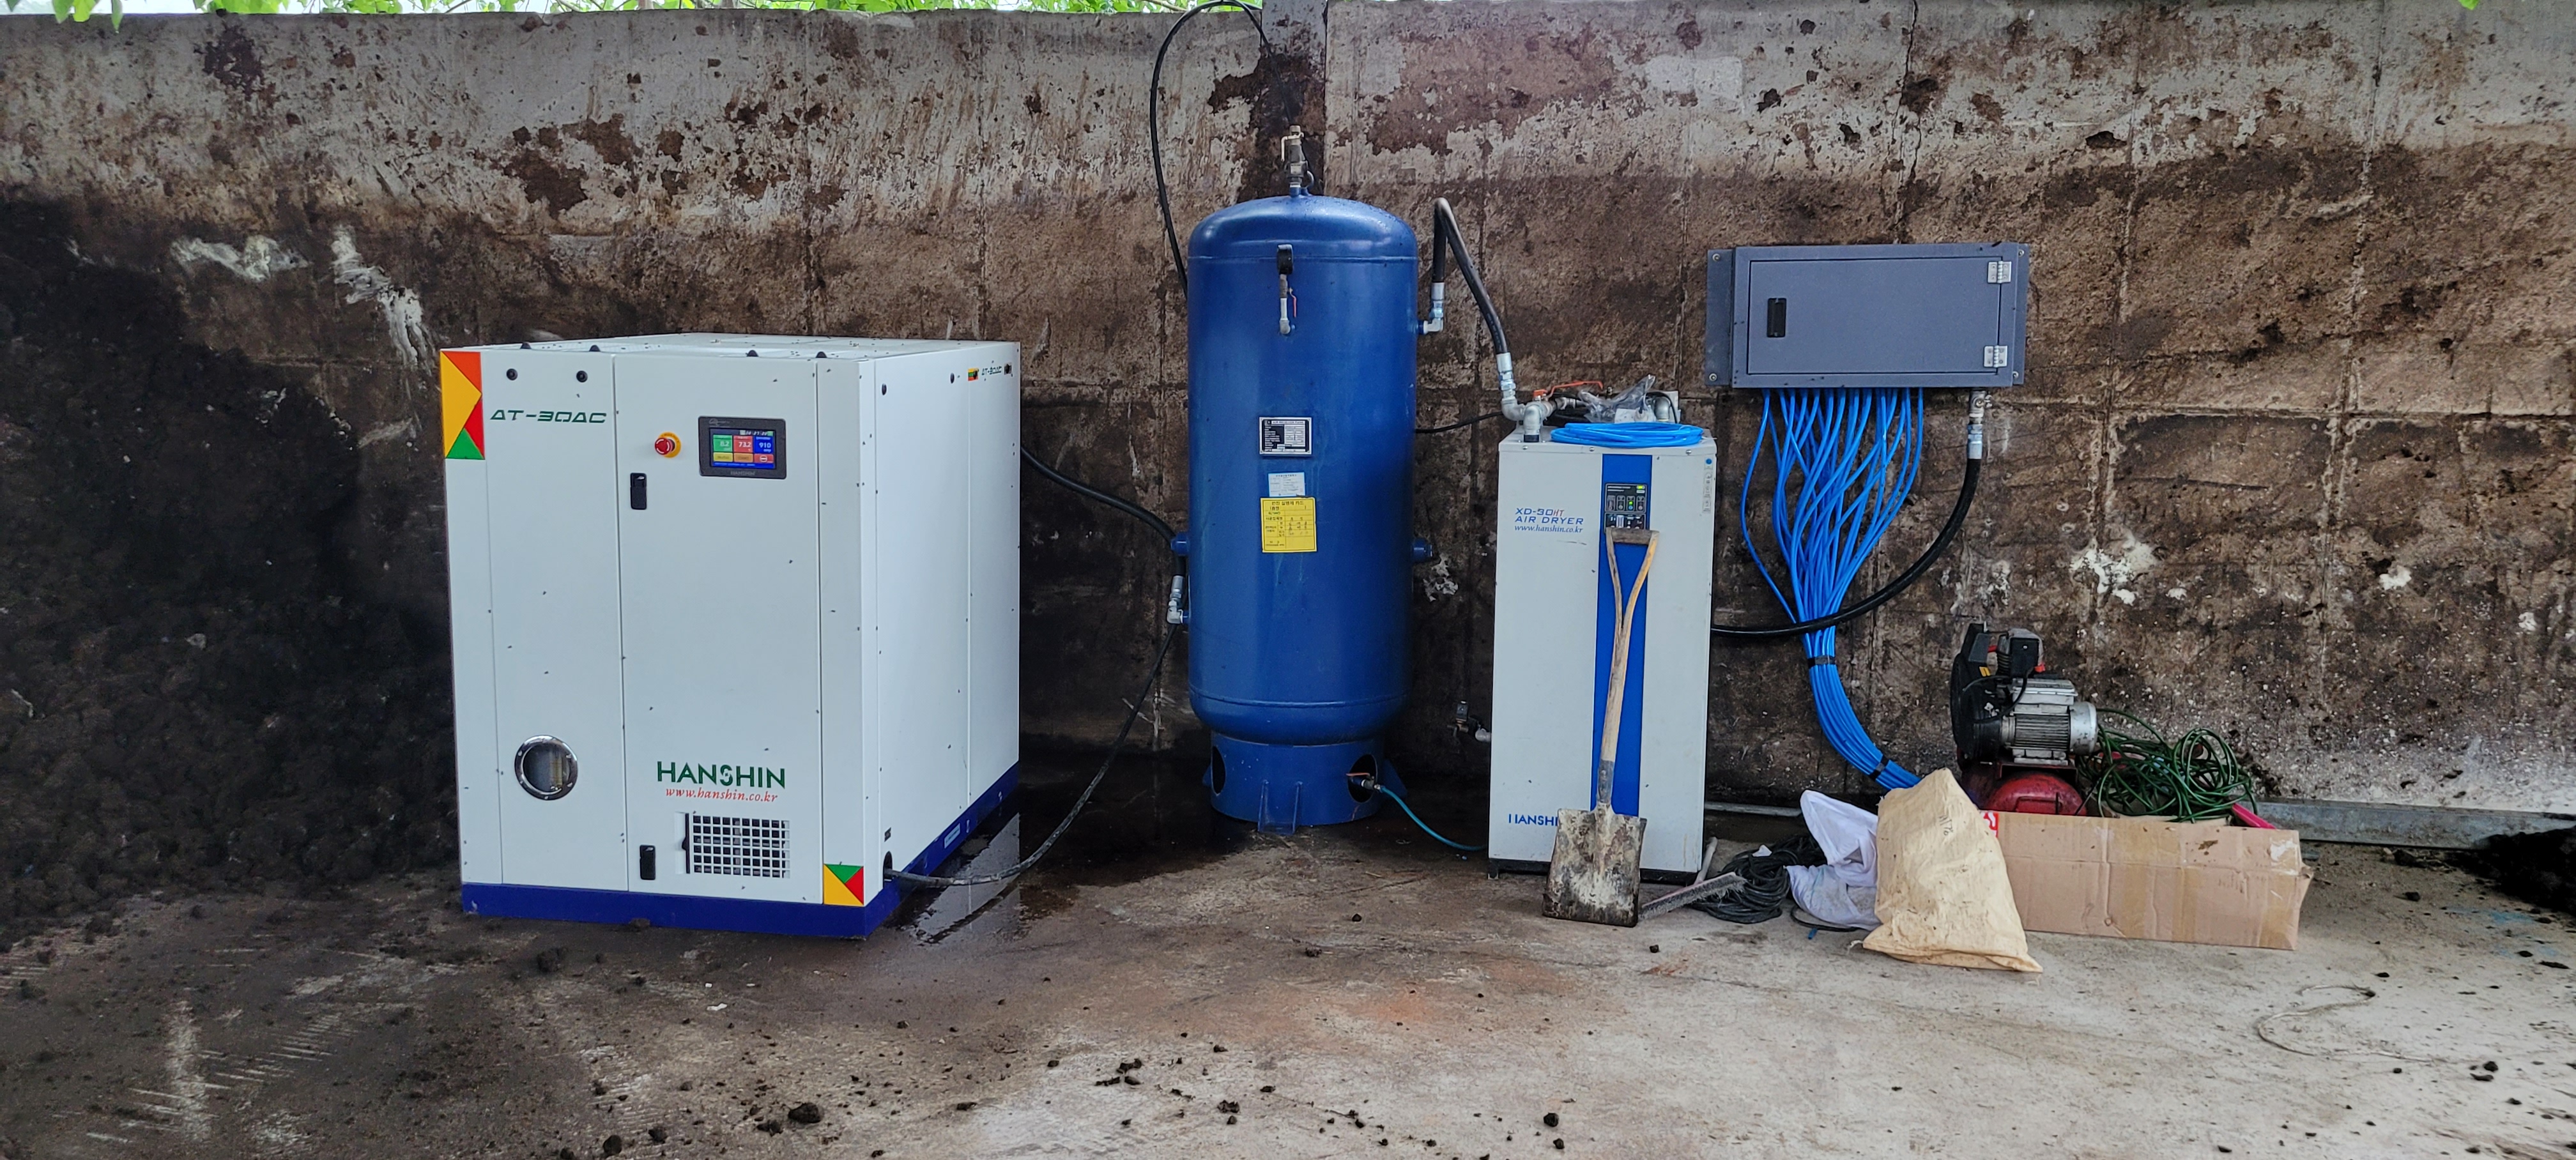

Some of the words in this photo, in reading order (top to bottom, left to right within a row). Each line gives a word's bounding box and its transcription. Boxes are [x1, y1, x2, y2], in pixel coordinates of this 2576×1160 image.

[490, 409, 606, 423] AT-30AC
[1515, 508, 1564, 517] XD-30HT
[1542, 517, 1584, 525] DRYER
[1514, 524, 1583, 533] www.hanshin.co.kr
[657, 761, 785, 789] HANSHIN
[666, 787, 778, 802] www.hanshin.co.kr
[1508, 814, 1558, 827] HANSHI
